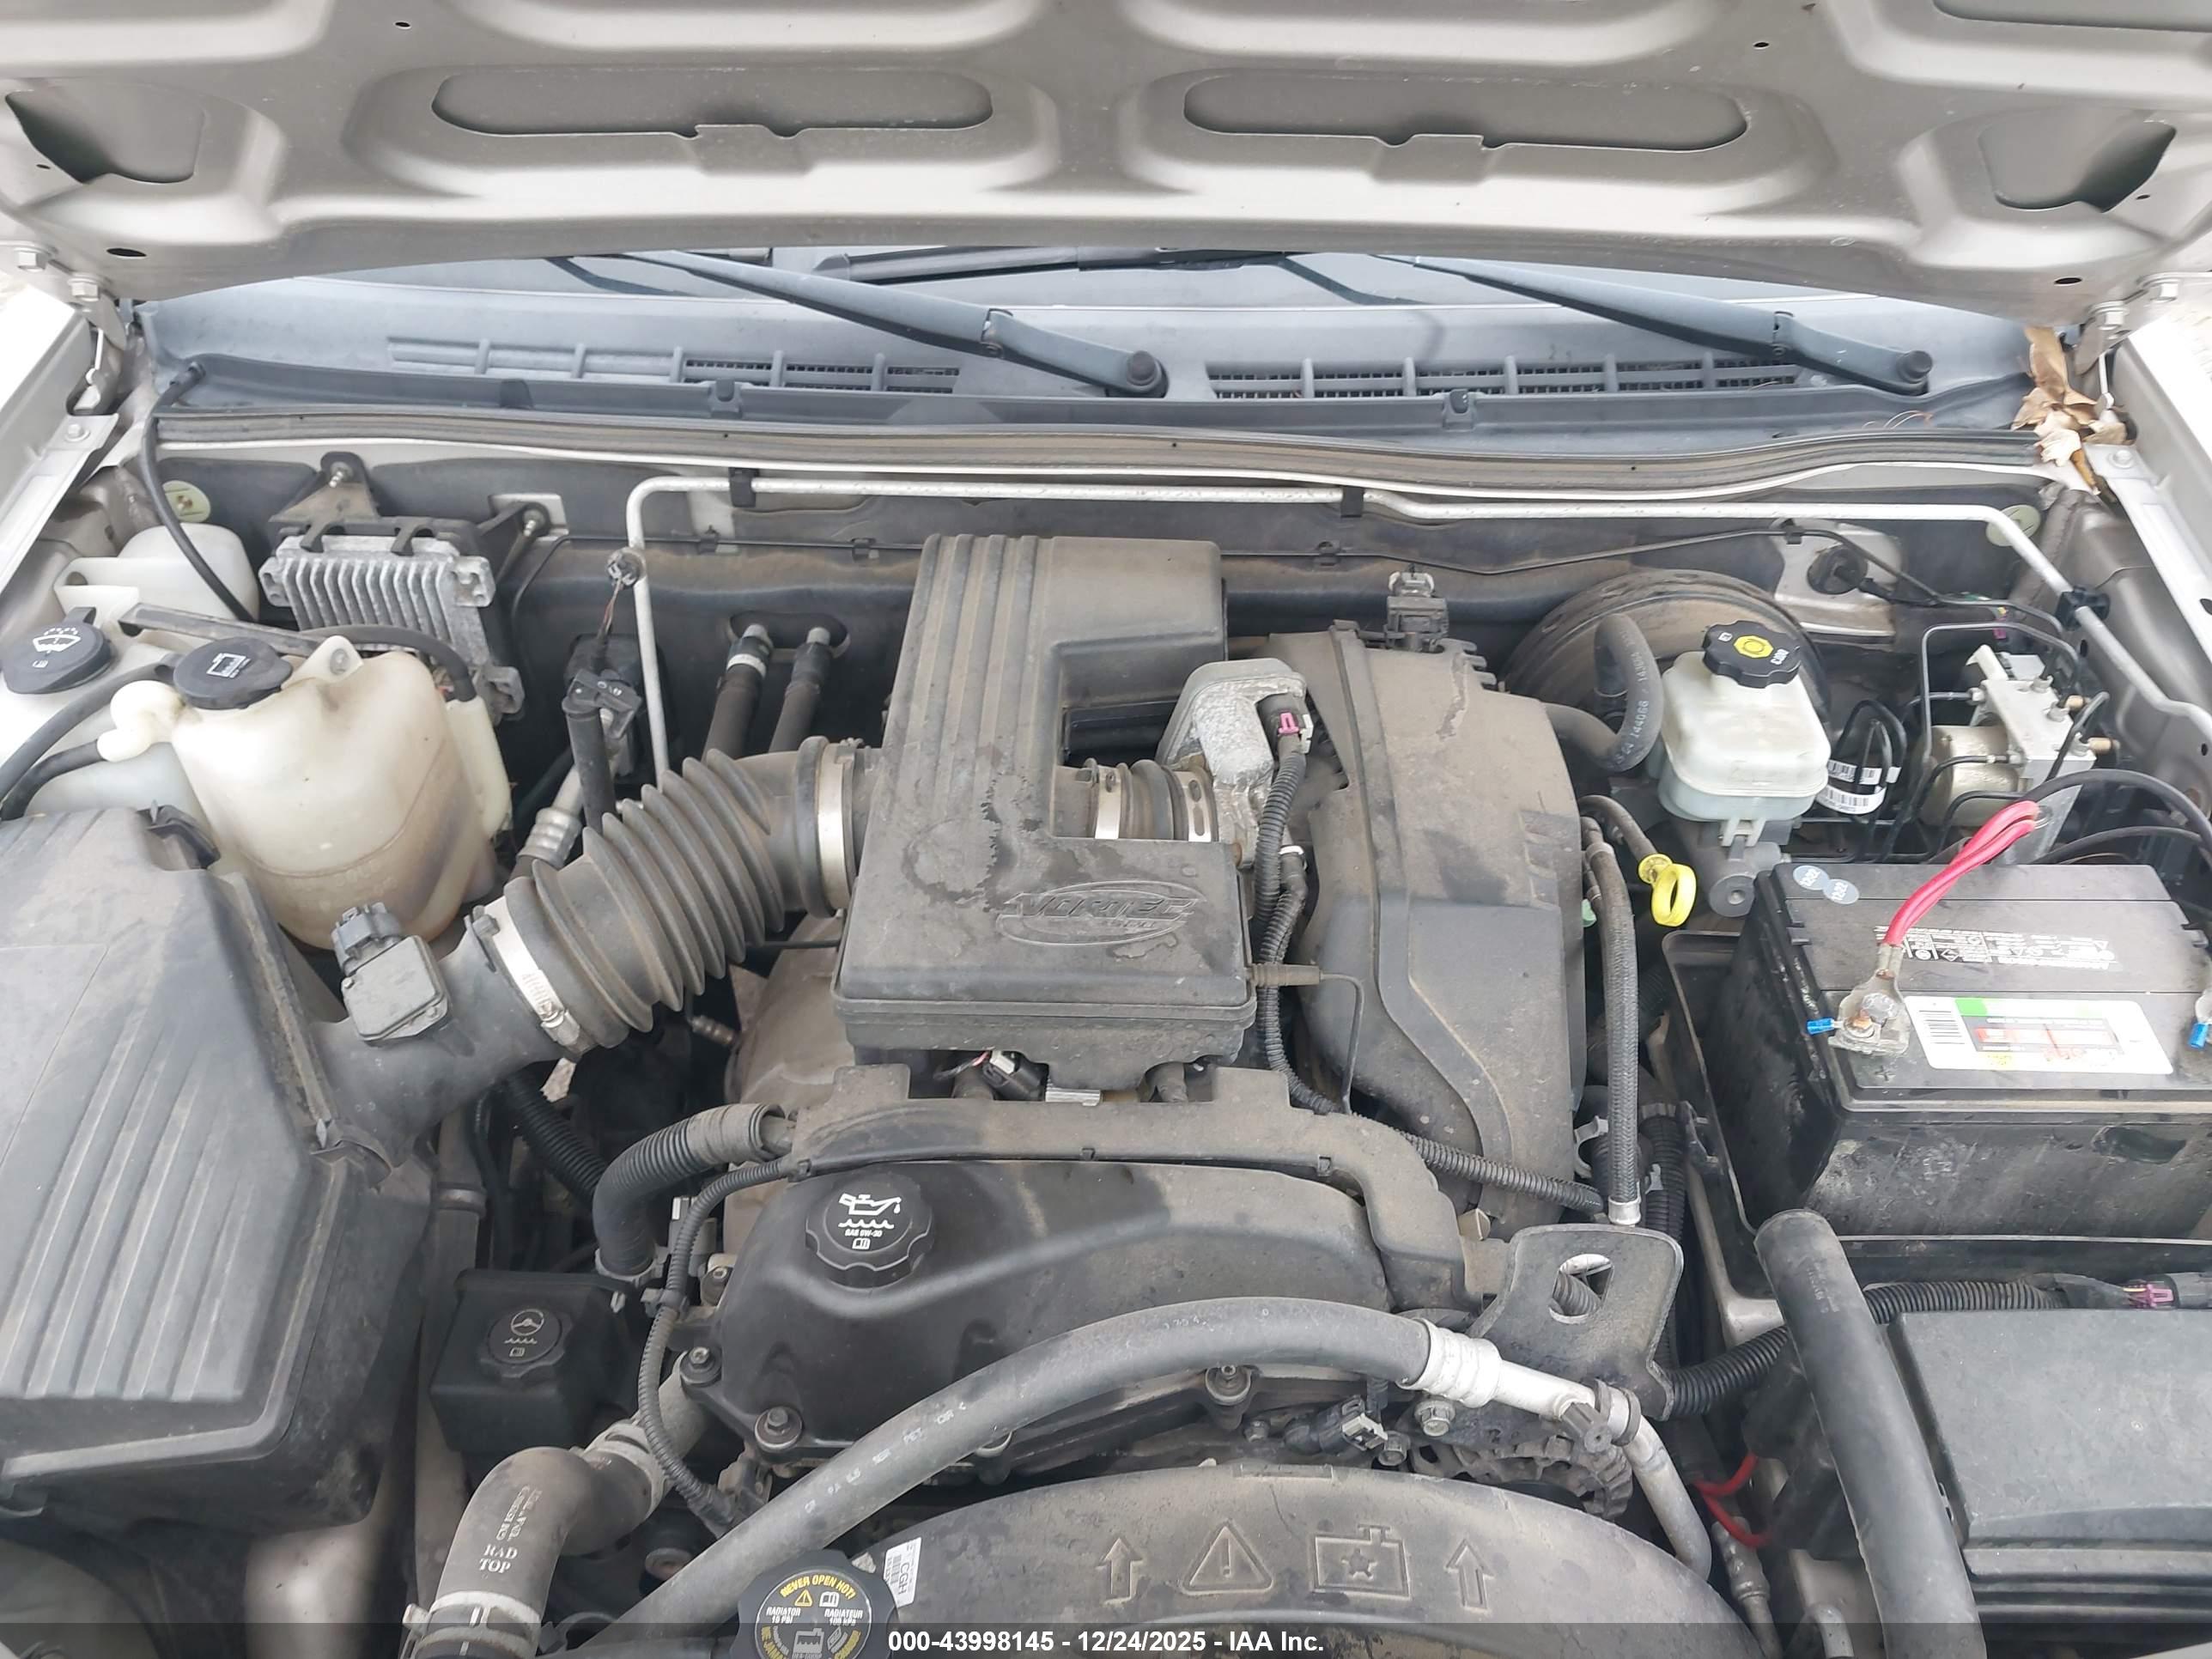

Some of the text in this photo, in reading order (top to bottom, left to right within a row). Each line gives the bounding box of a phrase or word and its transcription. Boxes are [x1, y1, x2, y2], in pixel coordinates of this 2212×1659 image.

[1003, 893, 1199, 922] VORTEC
[483, 1544, 518, 1559] RAD
[478, 1558, 512, 1574] TOP
[780, 1576, 810, 1597] NEVER
[811, 1575, 837, 1587] OPEN
[765, 1606, 801, 1616] RADIATOR
[823, 1607, 863, 1619] RADIATEUR
